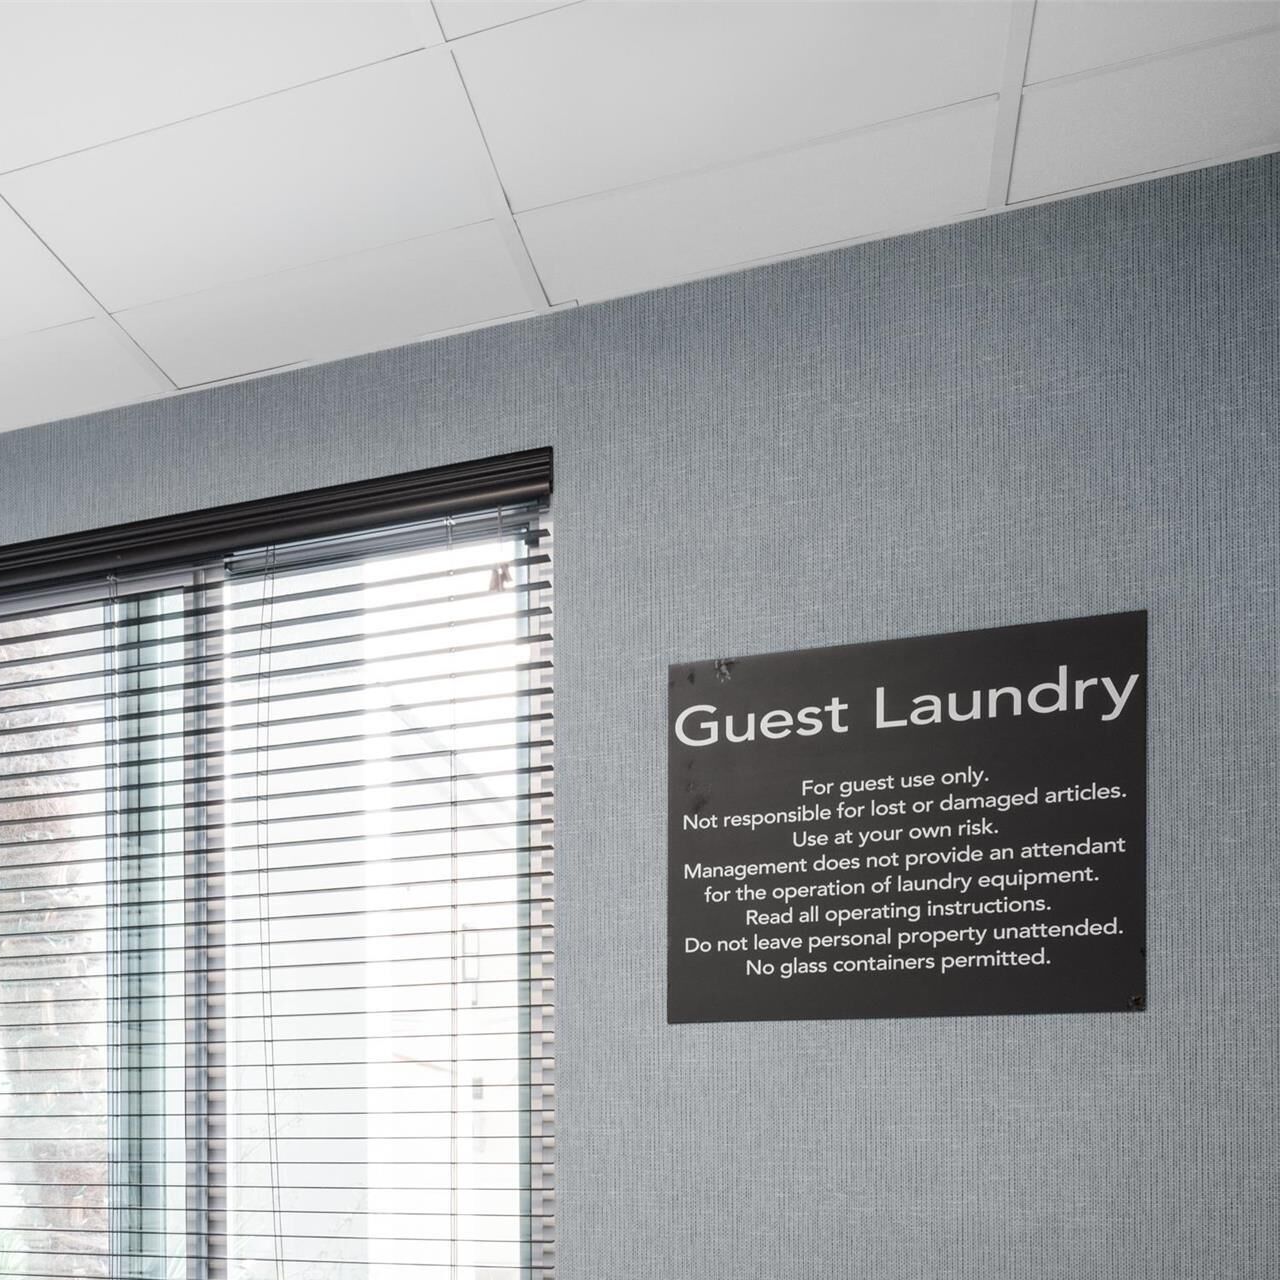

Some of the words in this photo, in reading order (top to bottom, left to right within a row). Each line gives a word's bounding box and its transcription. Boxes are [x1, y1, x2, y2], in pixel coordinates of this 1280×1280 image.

[674, 696, 848, 747] Guest
[876, 664, 1139, 729] Laundry
[802, 779, 834, 796] For
[839, 775, 894, 797] guest
[900, 774, 935, 788] use
[941, 765, 989, 787] only.
[683, 813, 718, 830] Not
[723, 803, 831, 831] responsible
[836, 801, 865, 819] for
[871, 799, 906, 816] lost
[912, 800, 934, 813] or
[939, 786, 1038, 811] damaged
[1044, 782, 1126, 803] articles.
[792, 830, 829, 847] Use
[834, 829, 853, 845] at
[858, 828, 903, 848] your
[908, 825, 951, 839] own
[958, 817, 998, 836] risk.
[684, 858, 807, 881] Management
[812, 853, 860, 871] does
[866, 852, 899, 868] not
[905, 844, 983, 871] provide
[989, 847, 1013, 860] an
[1020, 836, 1126, 858] attendant
[703, 885, 731, 903] for
[735, 883, 767, 901] the
[772, 879, 865, 904] operation
[871, 875, 892, 893] of
[897, 871, 972, 893] laundry
[977, 866, 1099, 891] equipment.
[746, 906, 793, 925] Read
[798, 905, 819, 923] all
[824, 902, 920, 926] operating
[927, 896, 1051, 916] instructions.
[685, 937, 712, 953] Do
[717, 936, 748, 951] not
[753, 933, 803, 950] leave
[808, 927, 891, 953] personal
[898, 926, 987, 949] property
[993, 916, 1123, 940] unattended.
[746, 959, 775, 975] No
[780, 956, 827, 979] glass
[833, 953, 935, 972] containers
[941, 946, 1050, 974] permitted.
